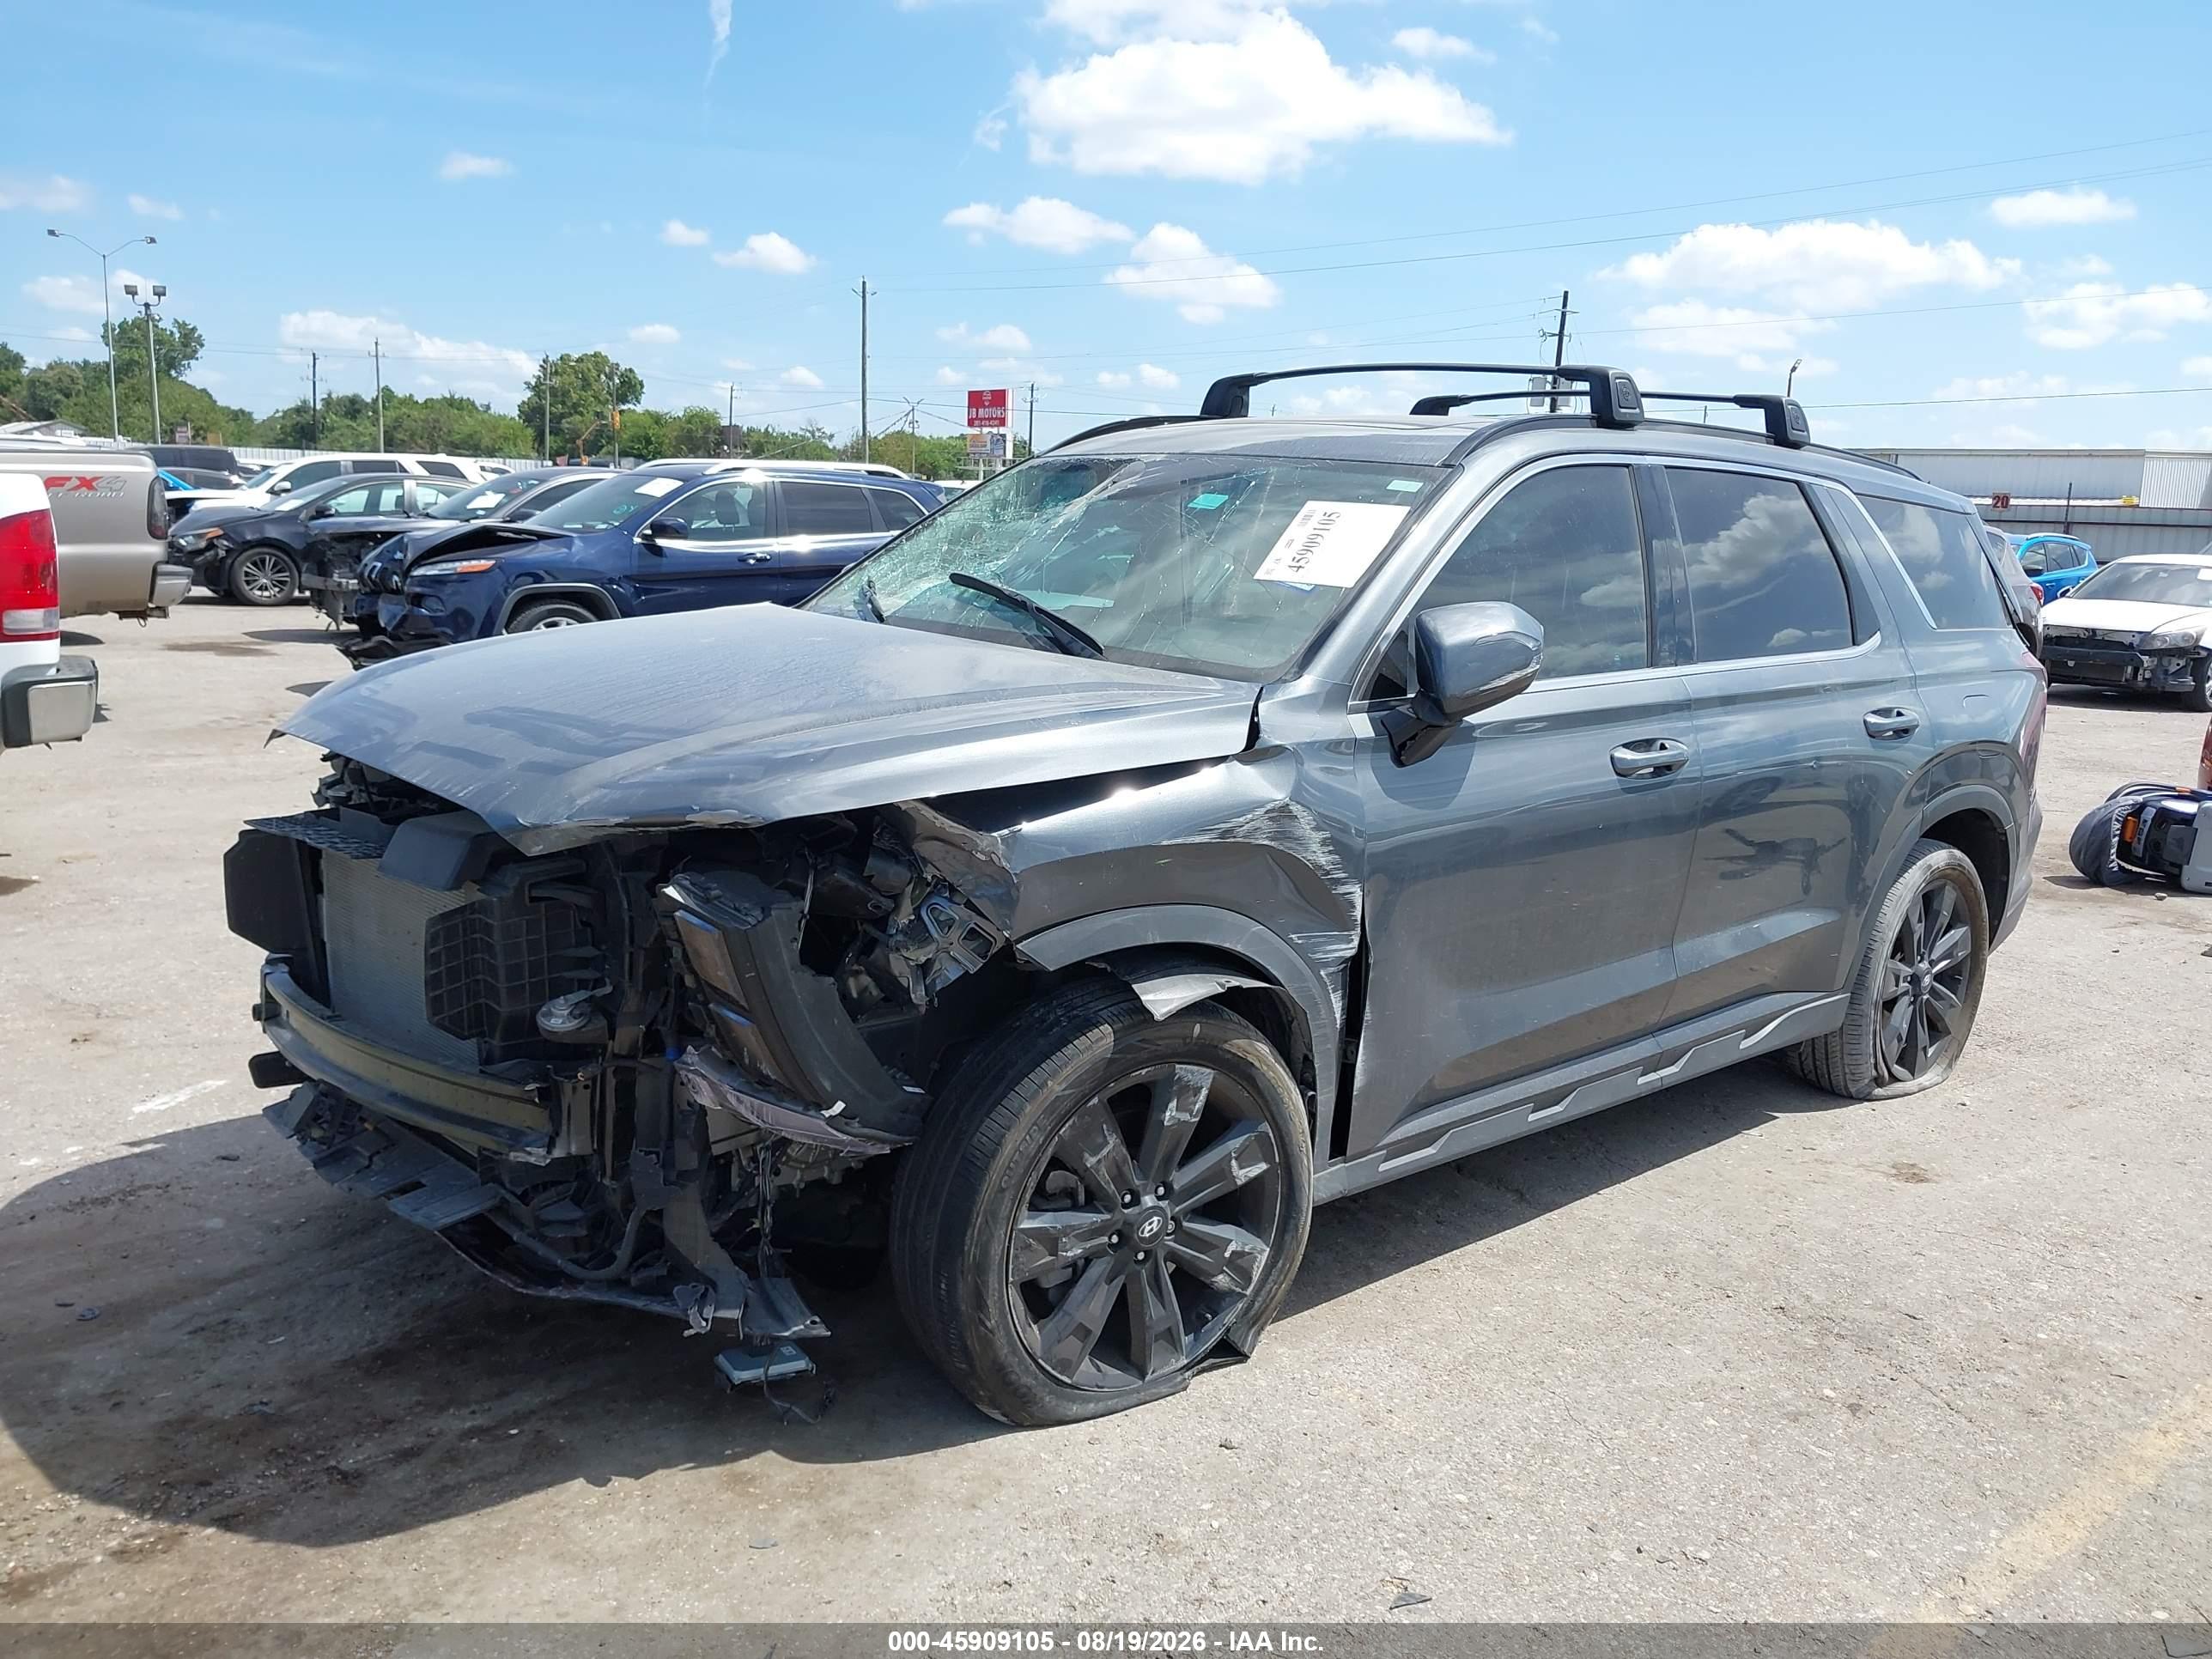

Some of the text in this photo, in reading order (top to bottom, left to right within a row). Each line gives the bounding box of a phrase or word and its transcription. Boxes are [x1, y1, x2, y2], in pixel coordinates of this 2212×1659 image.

[969, 406, 1006, 419] JB MOTORS
[44, 476, 128, 493] FX4
[1992, 495, 2009, 509] 20
[1287, 510, 1342, 574] 45909105
